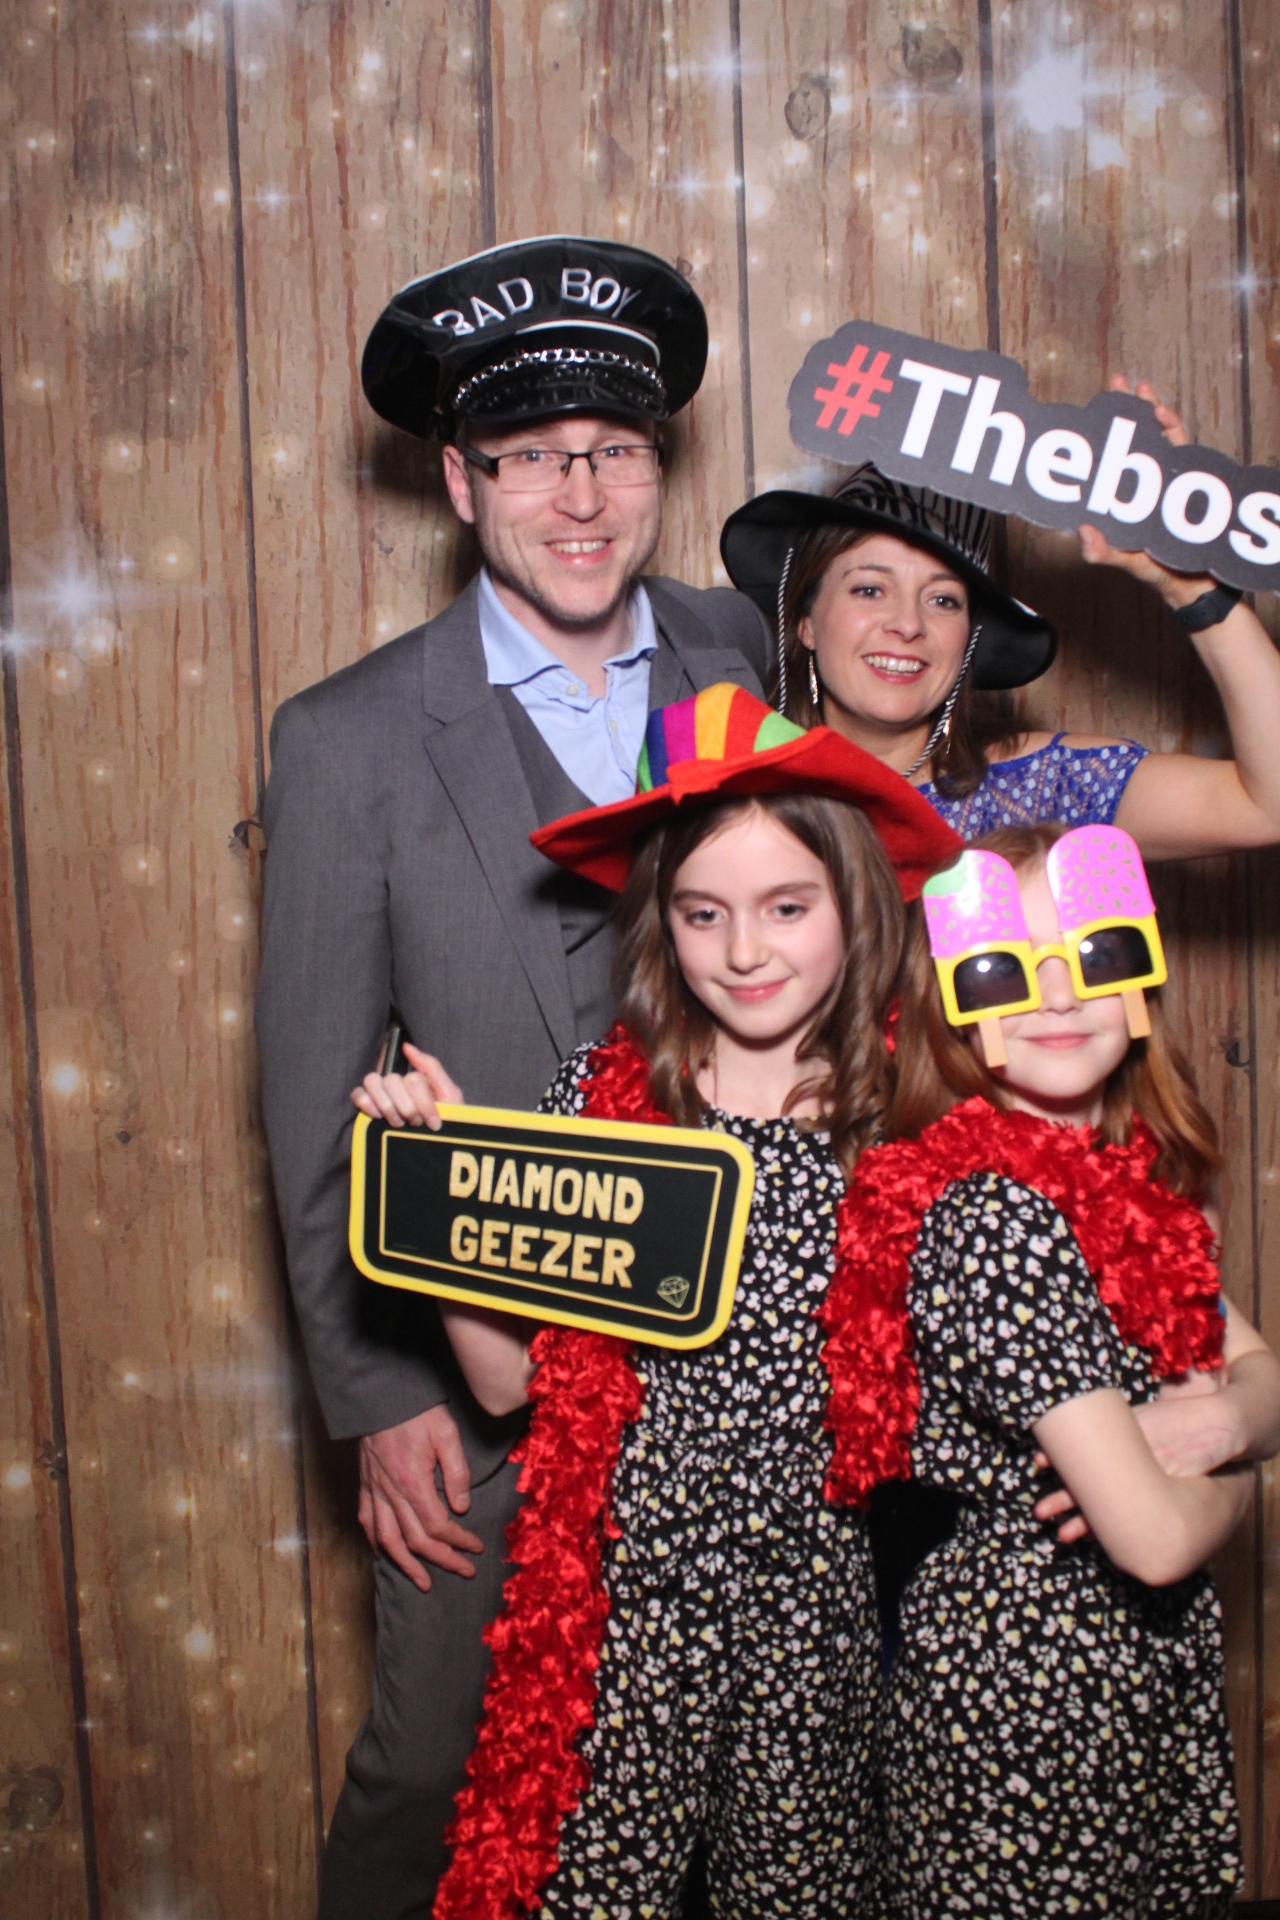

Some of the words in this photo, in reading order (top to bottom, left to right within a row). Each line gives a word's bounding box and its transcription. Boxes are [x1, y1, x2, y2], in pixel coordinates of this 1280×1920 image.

[560, 267, 642, 318] BOY
[813, 343, 1280, 565] #Thebos
[448, 1150, 645, 1225] DIAMOND
[450, 1214, 636, 1289] GEEZER
